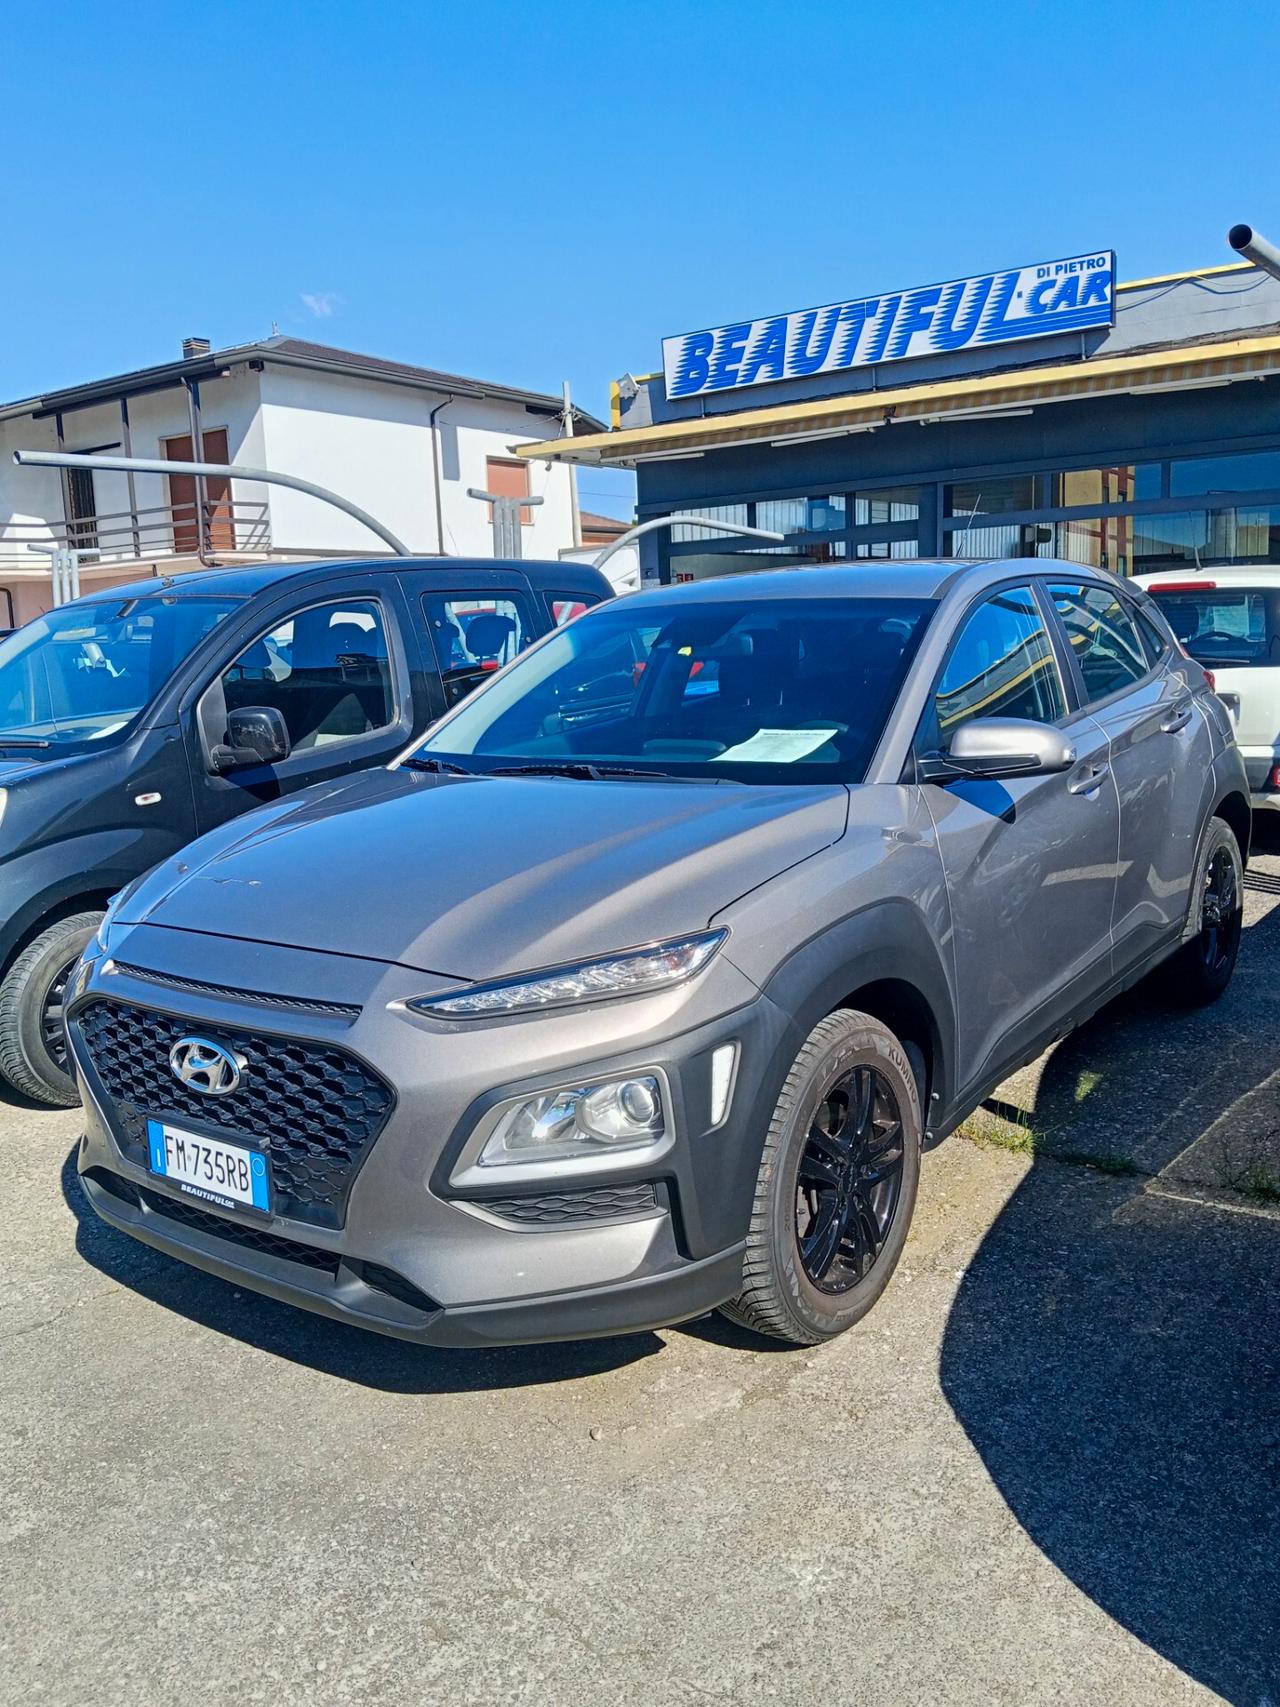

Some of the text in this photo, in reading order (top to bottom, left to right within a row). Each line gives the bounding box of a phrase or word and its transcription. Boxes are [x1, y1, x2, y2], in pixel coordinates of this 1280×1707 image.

[1036, 256, 1106, 279] DI PIETRO
[669, 270, 1111, 396] BEAUTIFUL CAR
